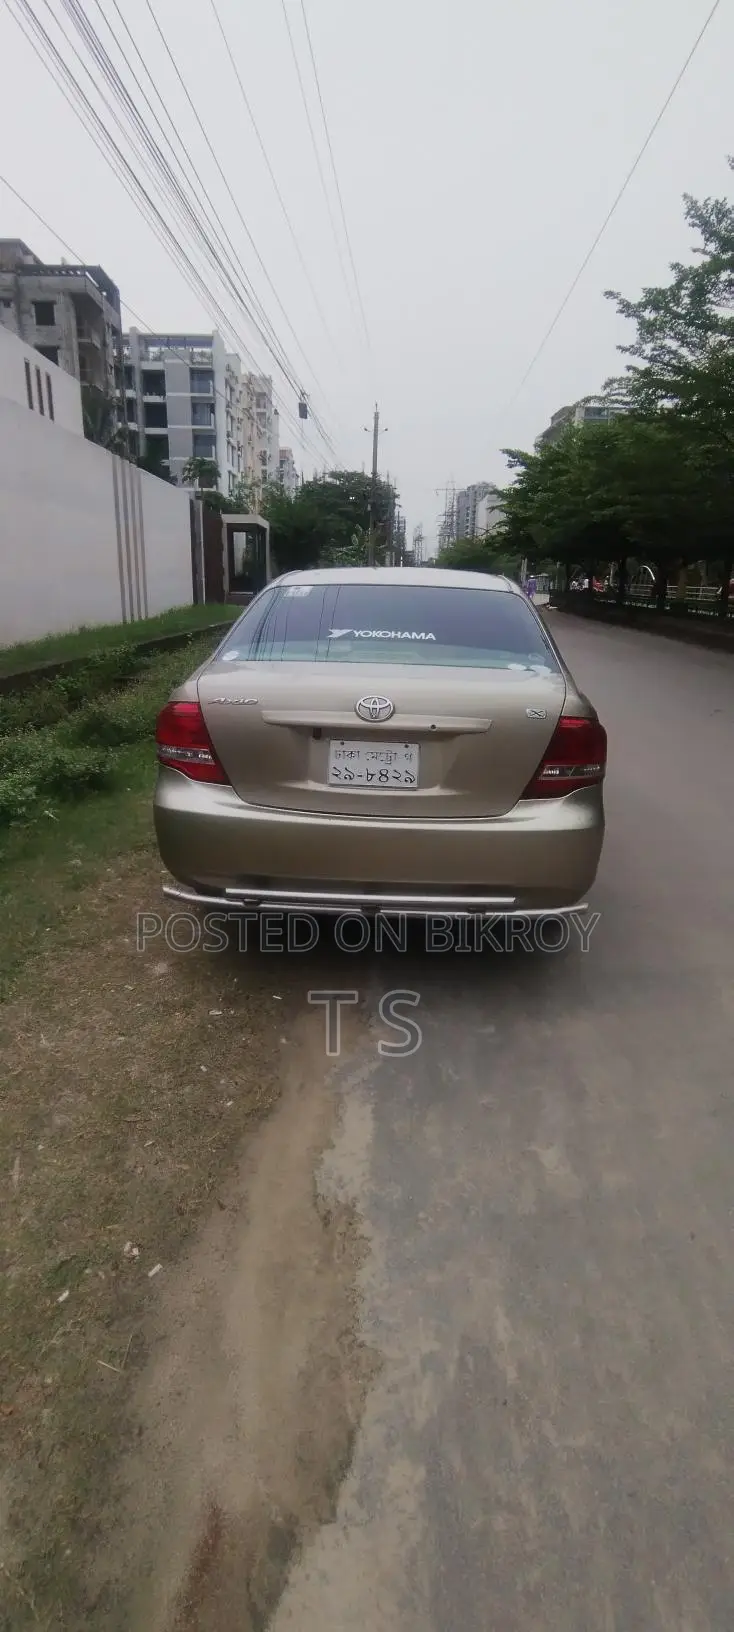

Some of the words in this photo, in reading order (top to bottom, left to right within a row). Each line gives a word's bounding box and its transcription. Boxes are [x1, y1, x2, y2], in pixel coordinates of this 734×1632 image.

[353, 630, 436, 640] YOKOHAMA
[335, 750, 360, 760] ঢাকা
[332, 766, 416, 784] ২৯-৮৪২৯
